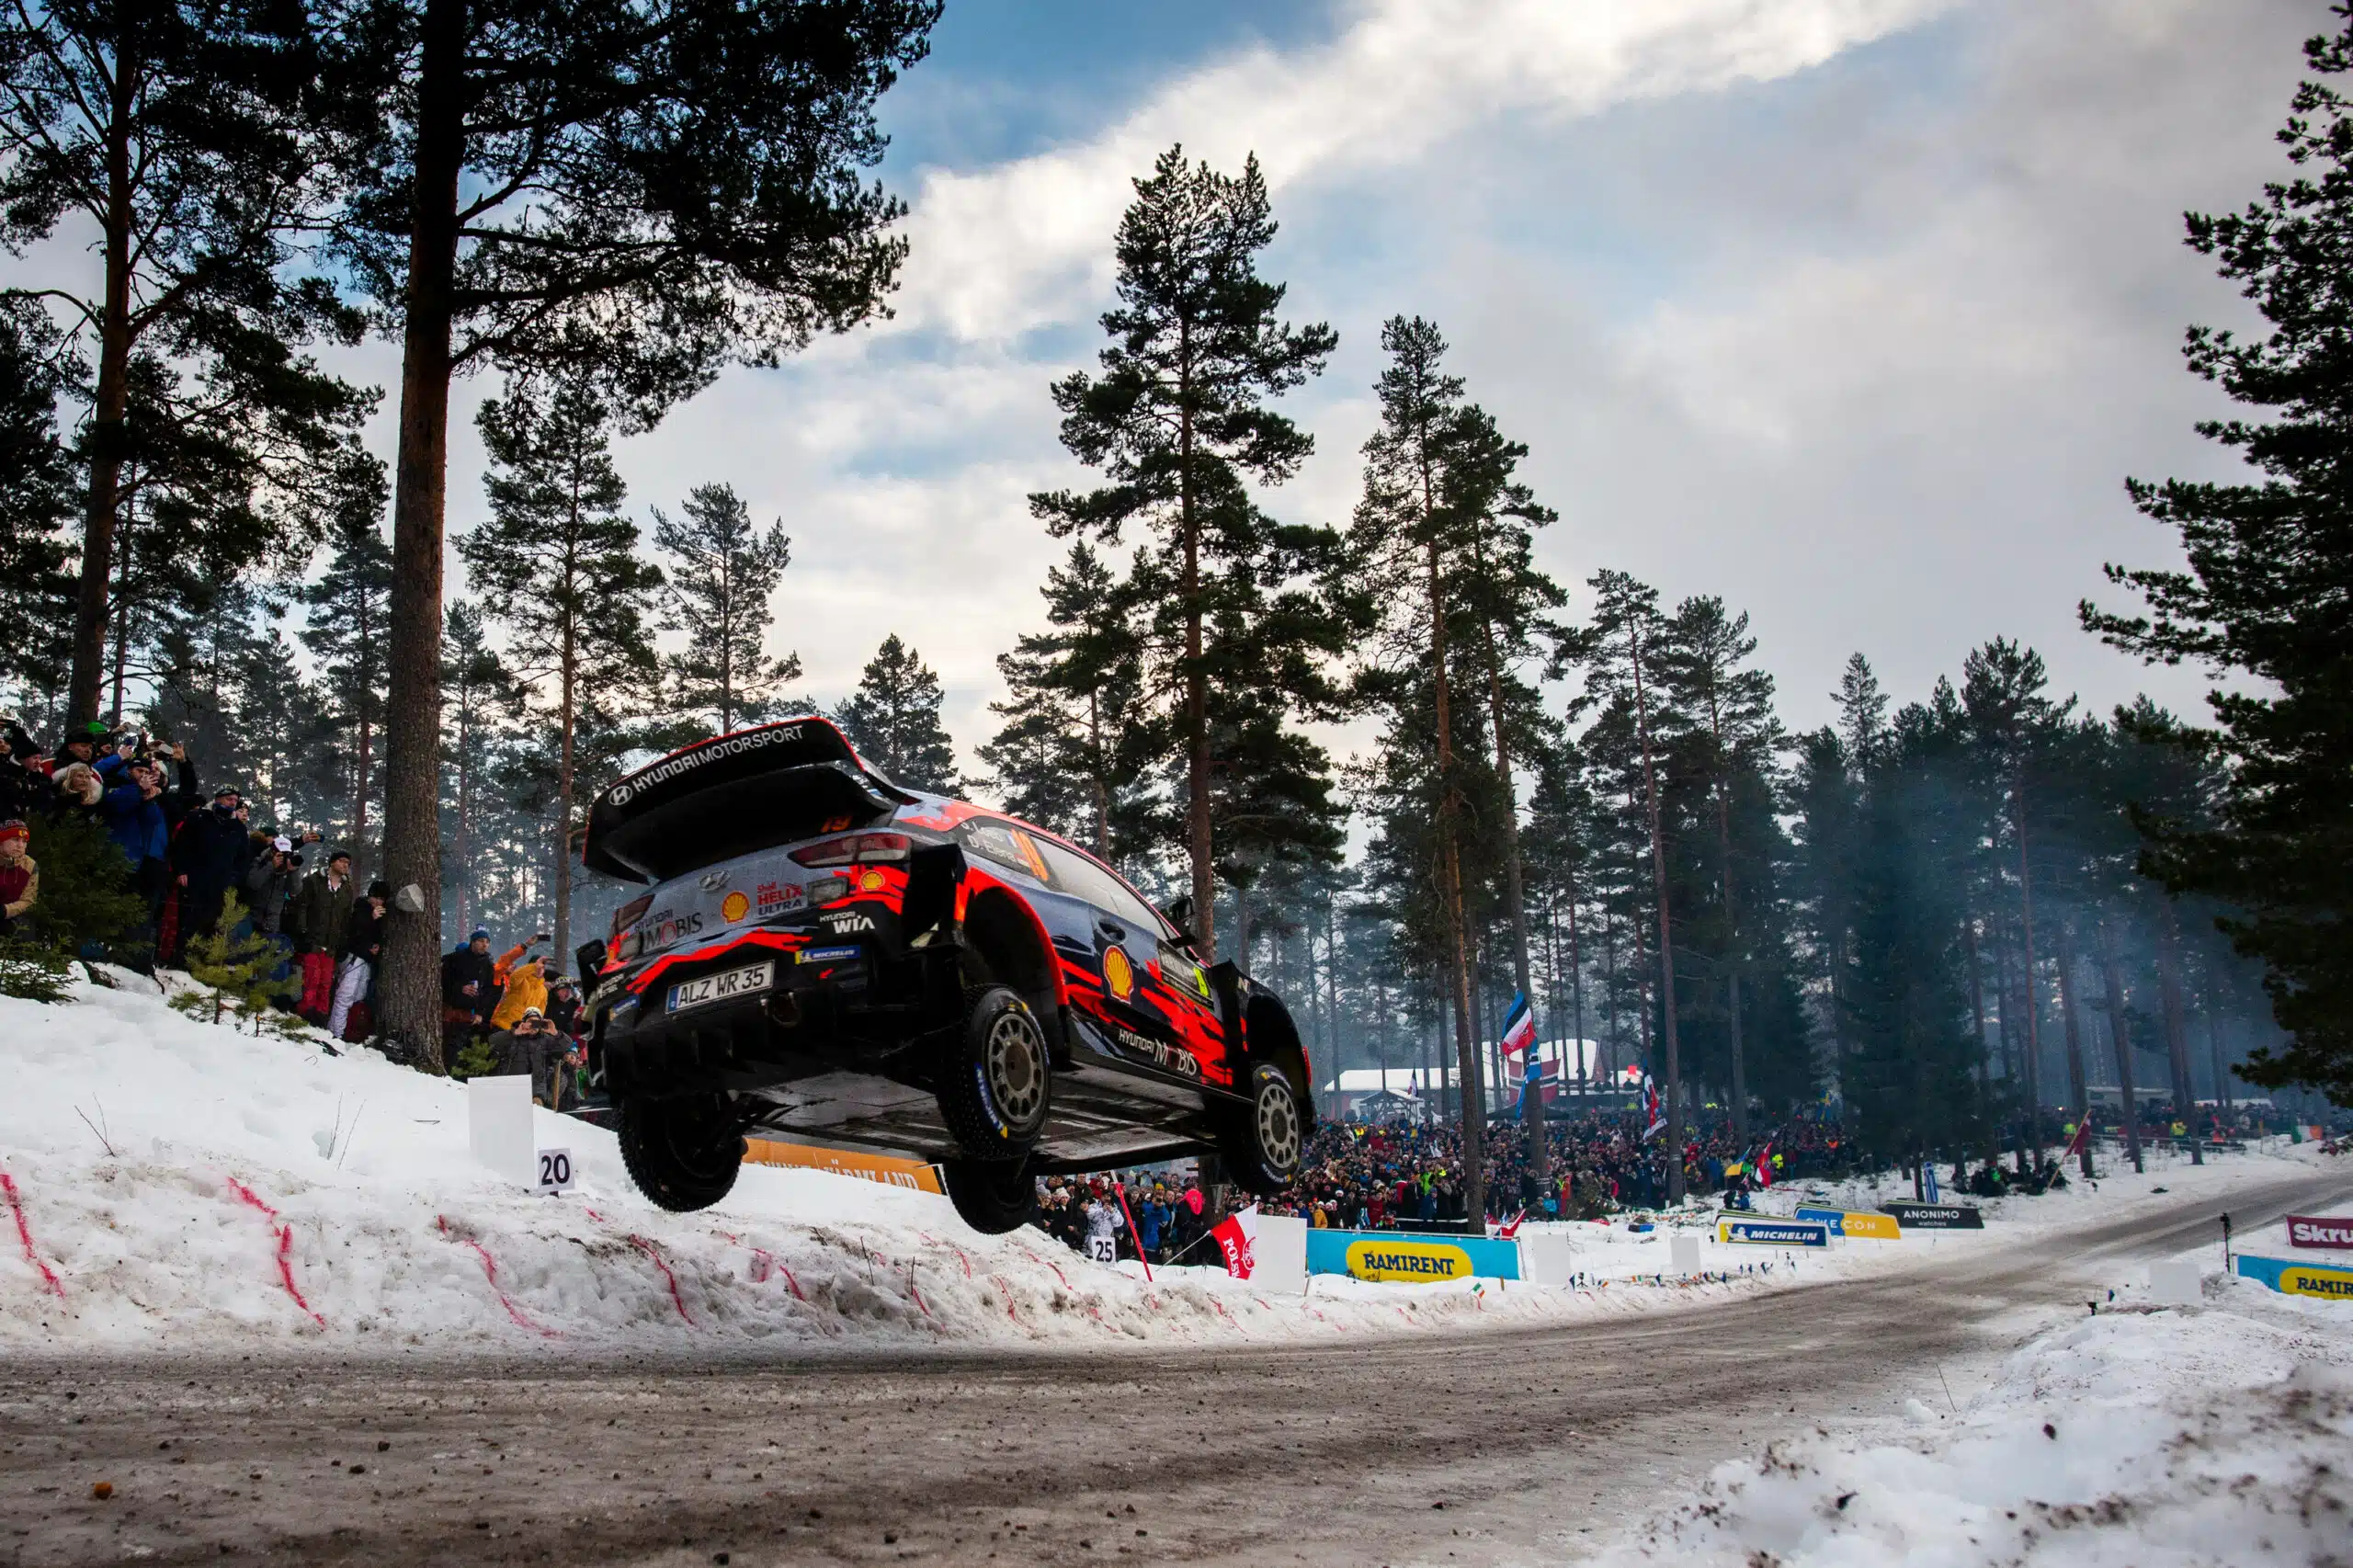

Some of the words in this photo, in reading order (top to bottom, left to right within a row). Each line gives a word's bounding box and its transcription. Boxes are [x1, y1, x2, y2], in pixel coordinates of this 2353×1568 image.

[632, 753, 700, 792] HYUNDAI
[699, 725, 804, 765] MOTORSPORT
[756, 883, 802, 906] HELIX
[757, 898, 802, 916] ULTRA
[820, 911, 856, 923] HYUNDAI
[643, 912, 703, 953] MOBIS
[678, 980, 711, 1006] ALZ
[717, 972, 739, 996] WR
[742, 966, 766, 990] 35
[1118, 1028, 1155, 1054] HYUNDAI
[1154, 1039, 1198, 1076] MOBIS
[541, 1153, 571, 1186] 20
[1904, 1210, 1960, 1220] ANONIMO
[1750, 1230, 1818, 1241] MICHELIN
[1096, 1240, 1113, 1263] 25
[1362, 1253, 1454, 1276] RAMIRENT
